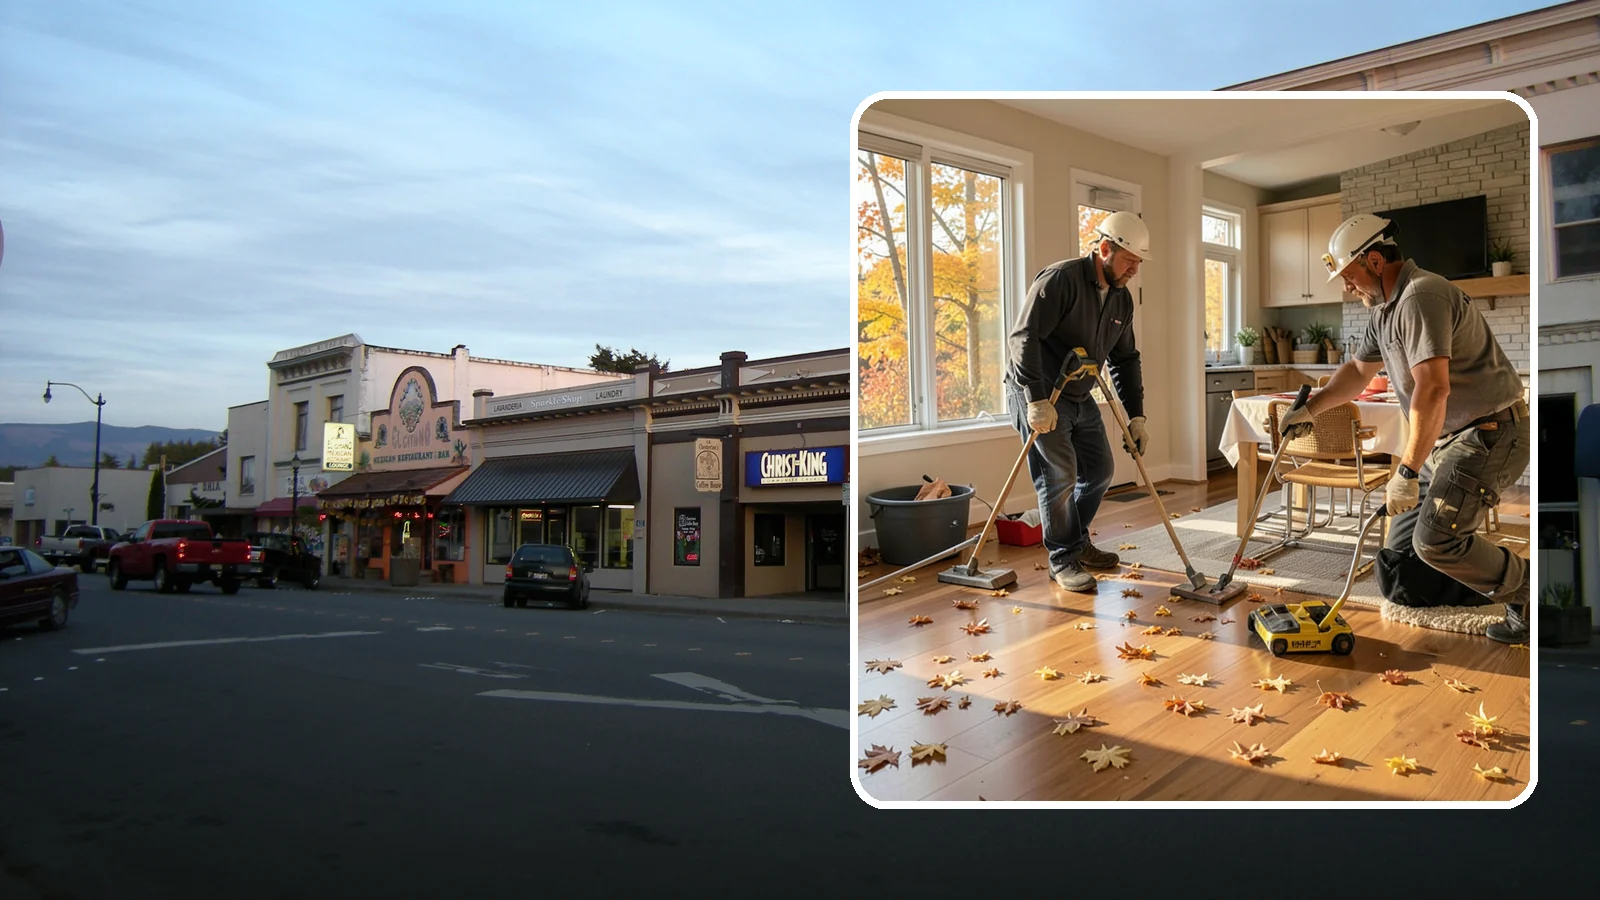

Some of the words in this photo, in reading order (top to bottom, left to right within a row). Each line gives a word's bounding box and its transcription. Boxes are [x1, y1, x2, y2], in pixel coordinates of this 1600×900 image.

[596, 389, 623, 400] LAUNDRY
[494, 402, 522, 412] LAVANDERIA
[397, 451, 433, 463] RESTAURANT
[438, 450, 450, 459] BAR
[761, 452, 797, 478] CHRIST
[799, 450, 827, 476] KING
